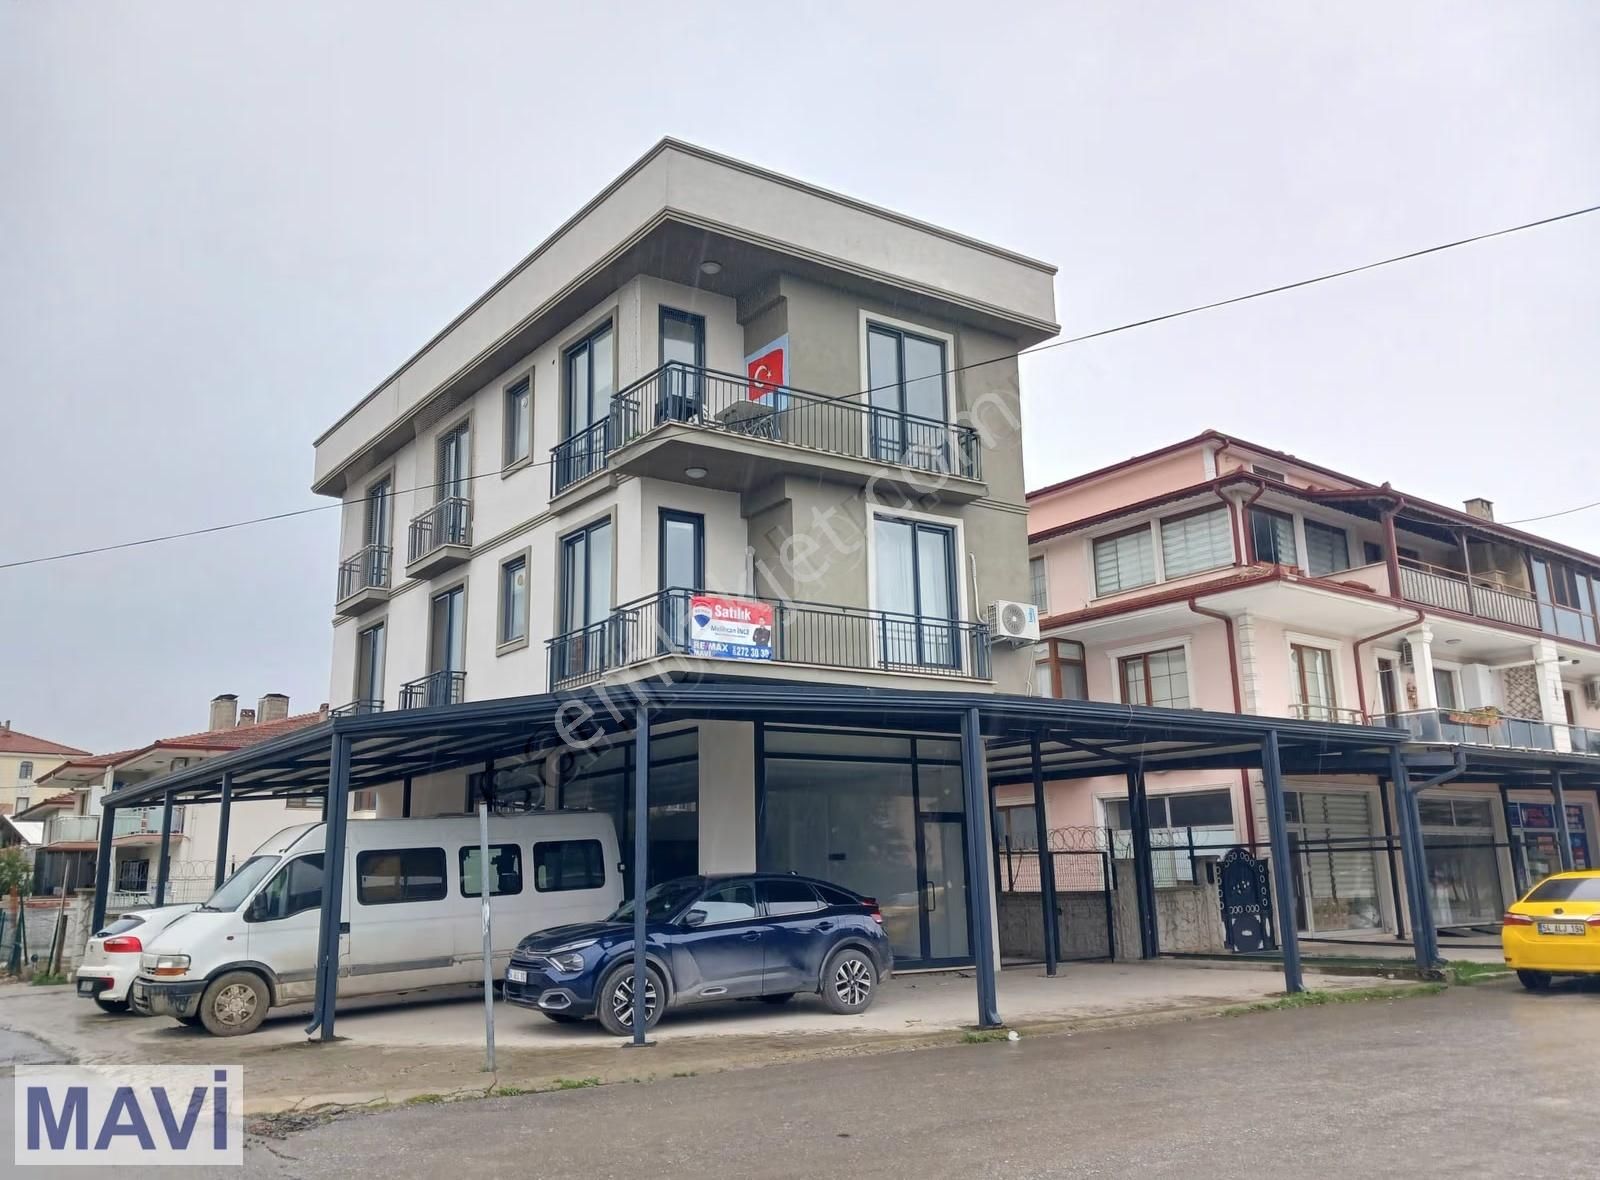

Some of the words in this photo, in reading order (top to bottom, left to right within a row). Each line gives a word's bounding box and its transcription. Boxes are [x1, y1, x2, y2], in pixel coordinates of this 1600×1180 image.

[714, 604, 752, 621] Satılık
[737, 646, 749, 657] 272
[750, 647, 759, 658] 30
